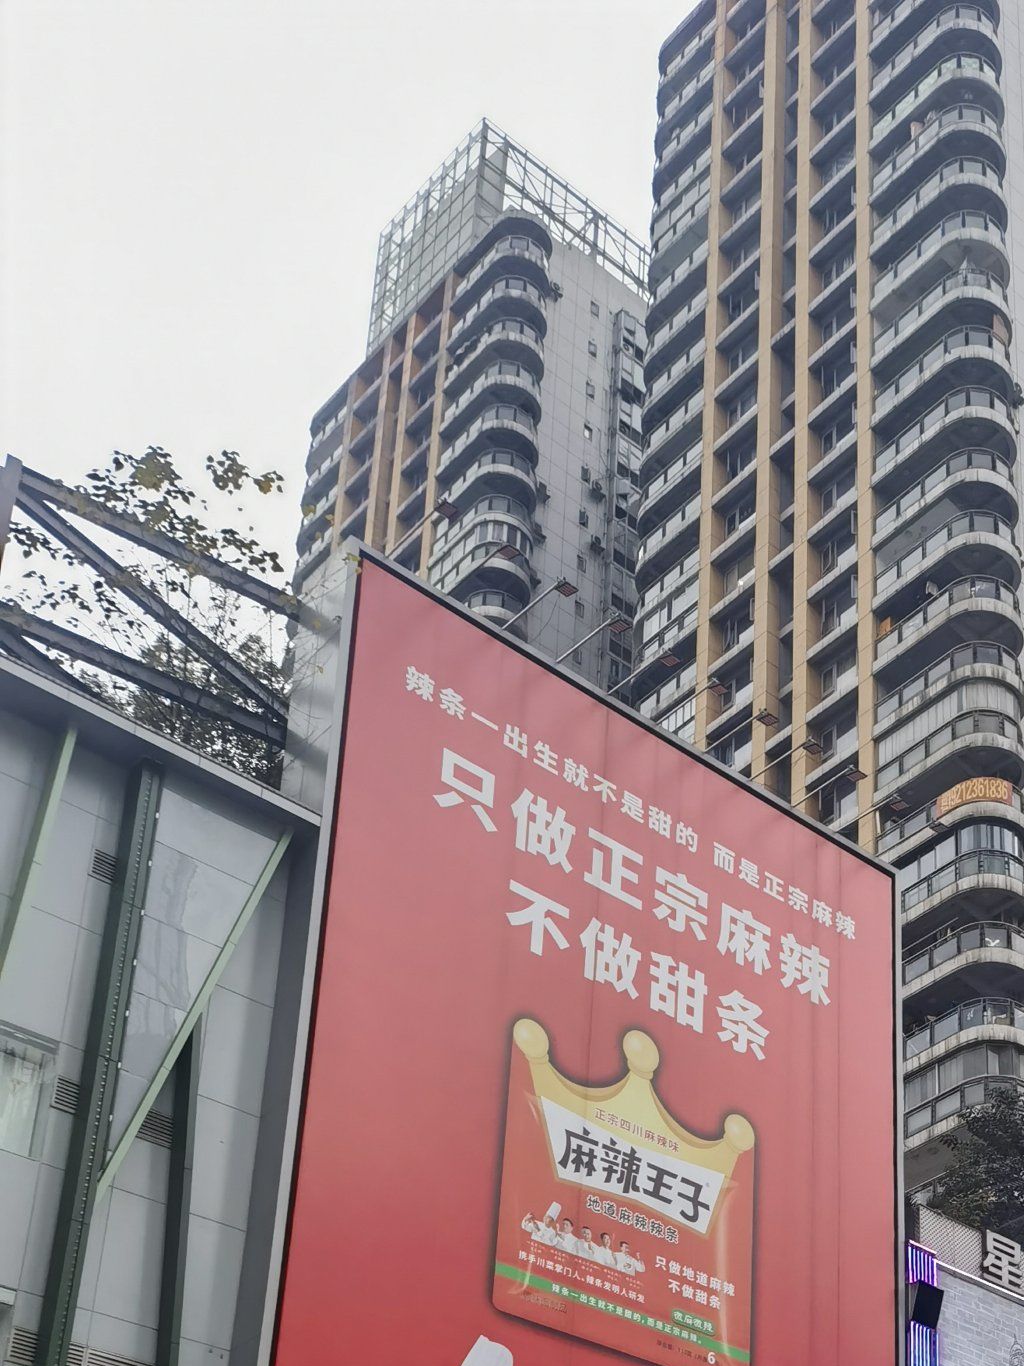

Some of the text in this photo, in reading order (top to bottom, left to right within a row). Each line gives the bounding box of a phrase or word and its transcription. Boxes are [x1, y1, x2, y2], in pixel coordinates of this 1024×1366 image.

[405, 665, 856, 940] 辣条一出生就不是甜的 而是正宗麻辣
[432, 747, 832, 1006] 只做正宗麻辣
[505, 879, 771, 1061] 不做甜条
[593, 1107, 680, 1154] 正宗四川麻辣味
[558, 1127, 711, 1223] 麻辣王子
[586, 1194, 679, 1245] 地道麻辣辣条
[654, 1255, 736, 1297] 只做地道麻辣
[667, 1278, 722, 1311] 不做甜条
